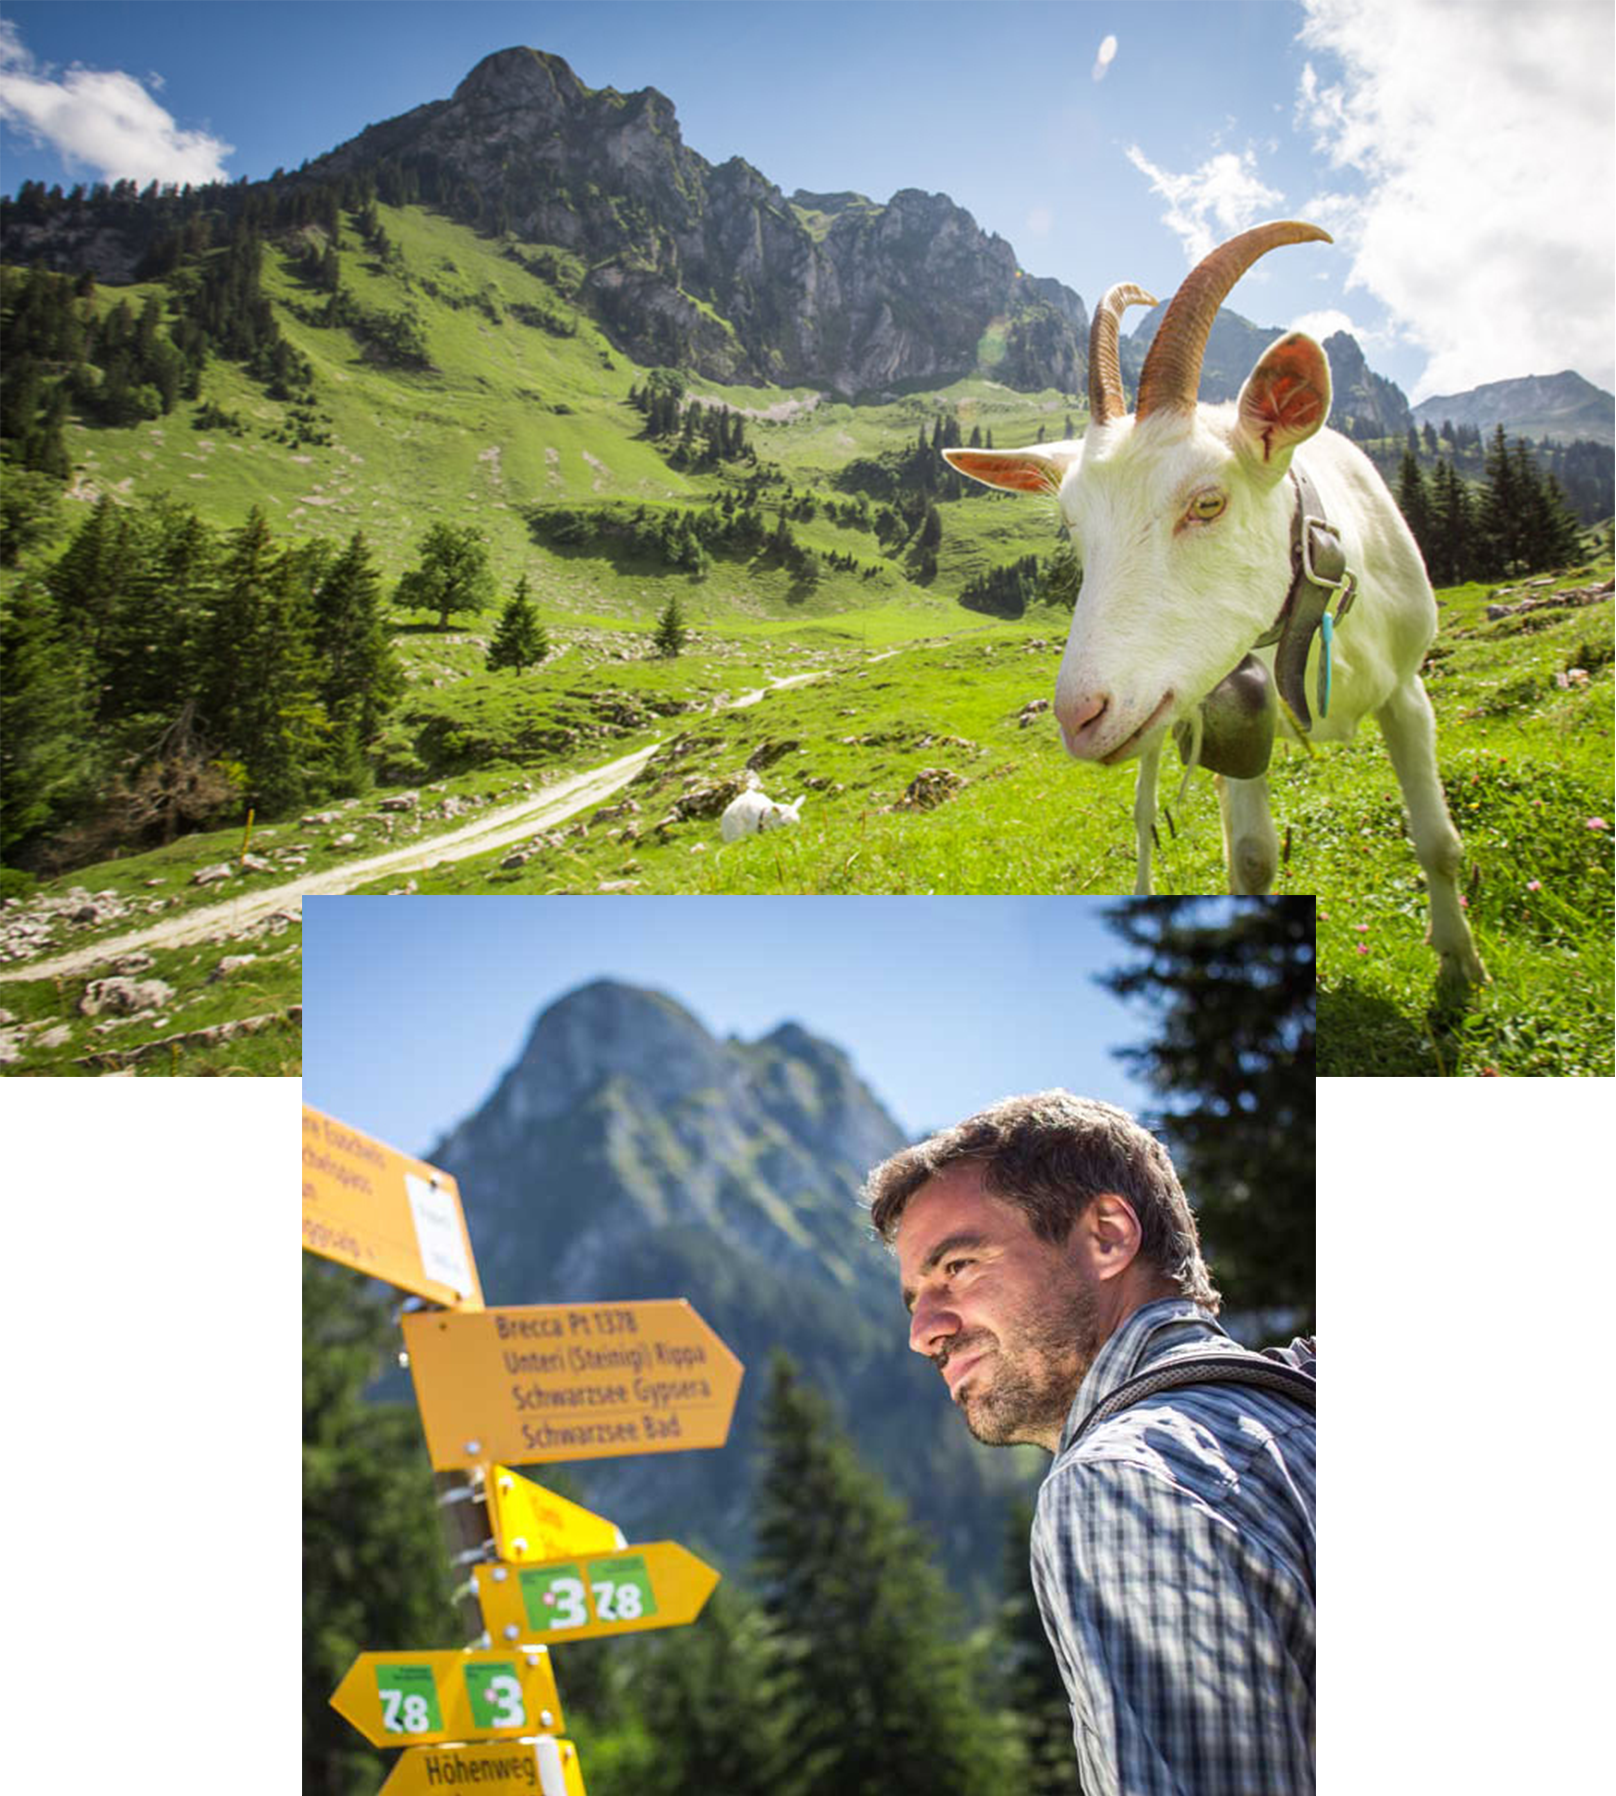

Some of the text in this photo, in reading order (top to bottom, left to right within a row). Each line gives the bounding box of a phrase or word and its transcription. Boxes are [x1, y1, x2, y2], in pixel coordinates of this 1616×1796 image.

[495, 1308, 639, 1341] Brecca Pt 1378
[503, 1350, 565, 1375] Unteri
[655, 1342, 707, 1370] Rippa
[511, 1377, 711, 1411] Schwarzsee Gypsera
[522, 1413, 682, 1450] Schwarzsee Bad
[548, 1577, 588, 1629] 3
[490, 1674, 526, 1729] 3
[425, 1753, 536, 1786] Höhenweg
